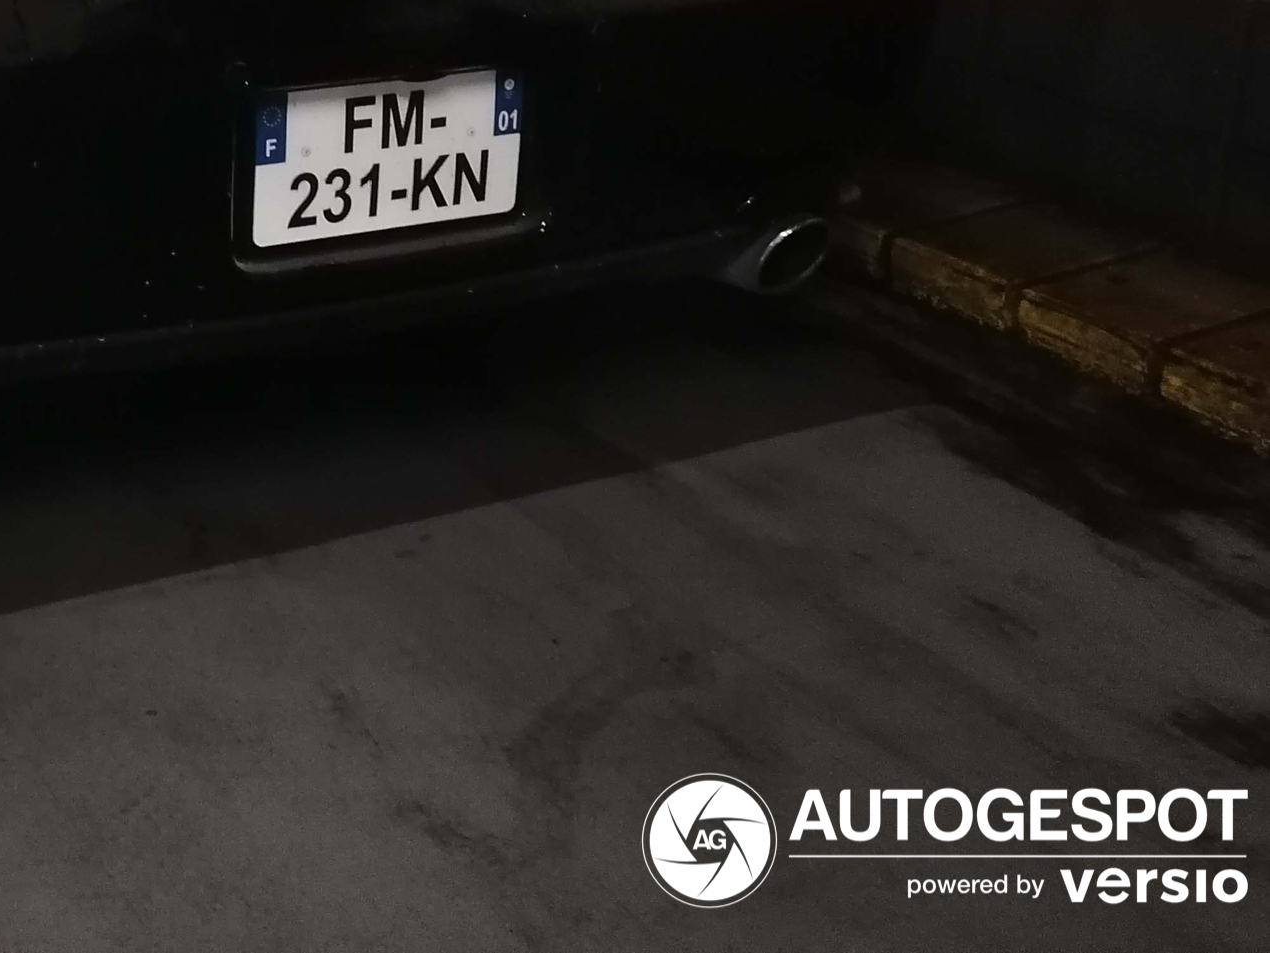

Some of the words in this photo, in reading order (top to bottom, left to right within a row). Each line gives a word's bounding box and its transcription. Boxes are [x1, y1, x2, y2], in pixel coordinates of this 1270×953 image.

[344, 90, 447, 154] FM-
[498, 109, 519, 132] 01
[265, 139, 278, 158] F
[287, 149, 489, 229] 231-KN
